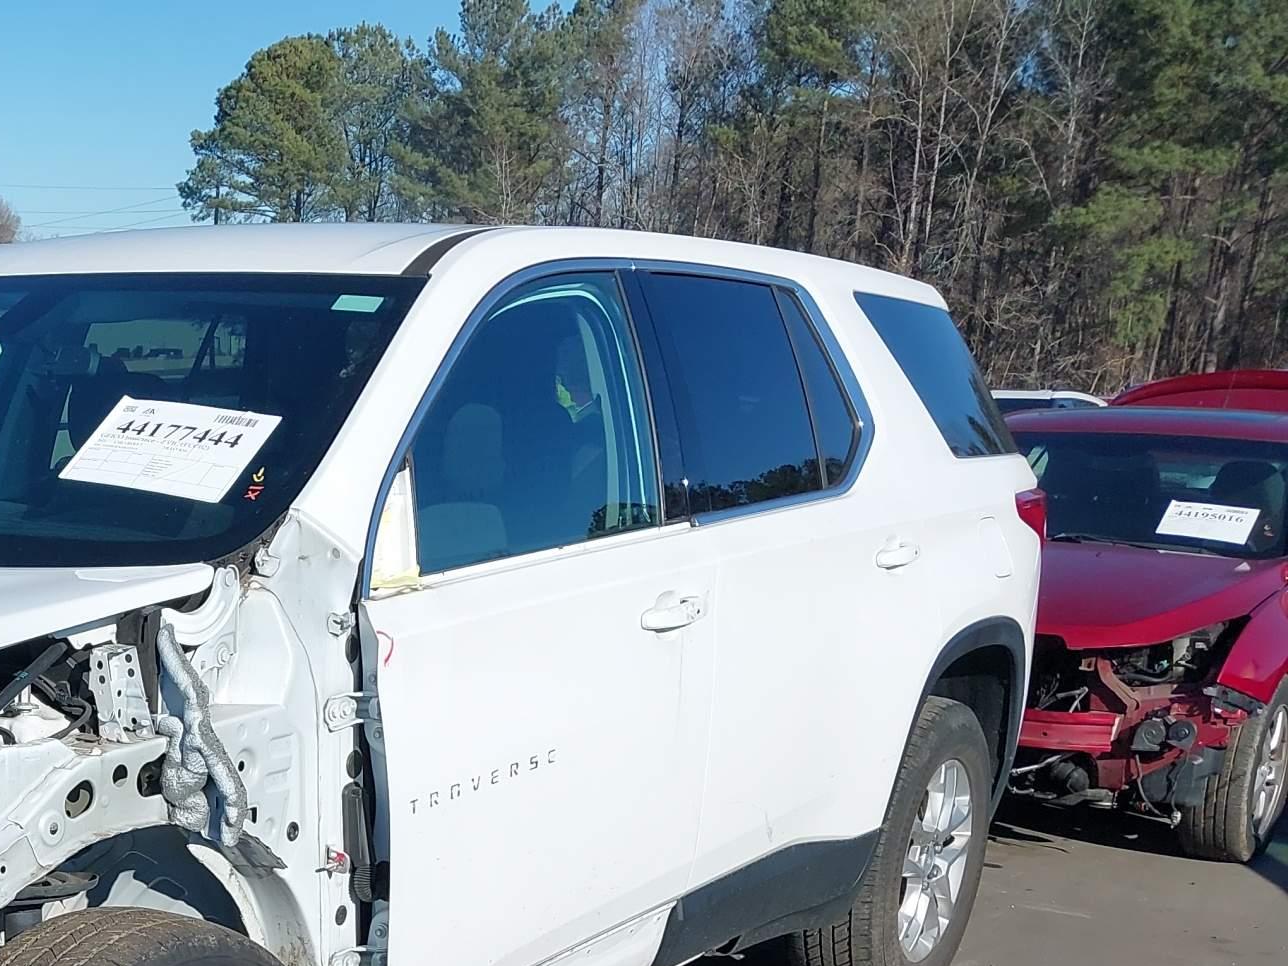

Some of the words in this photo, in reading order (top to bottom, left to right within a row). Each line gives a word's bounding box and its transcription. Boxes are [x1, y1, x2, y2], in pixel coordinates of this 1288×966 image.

[117, 420, 244, 448] 44177444
[1175, 510, 1245, 524] 44195016
[409, 749, 557, 815] TRAVERSE
